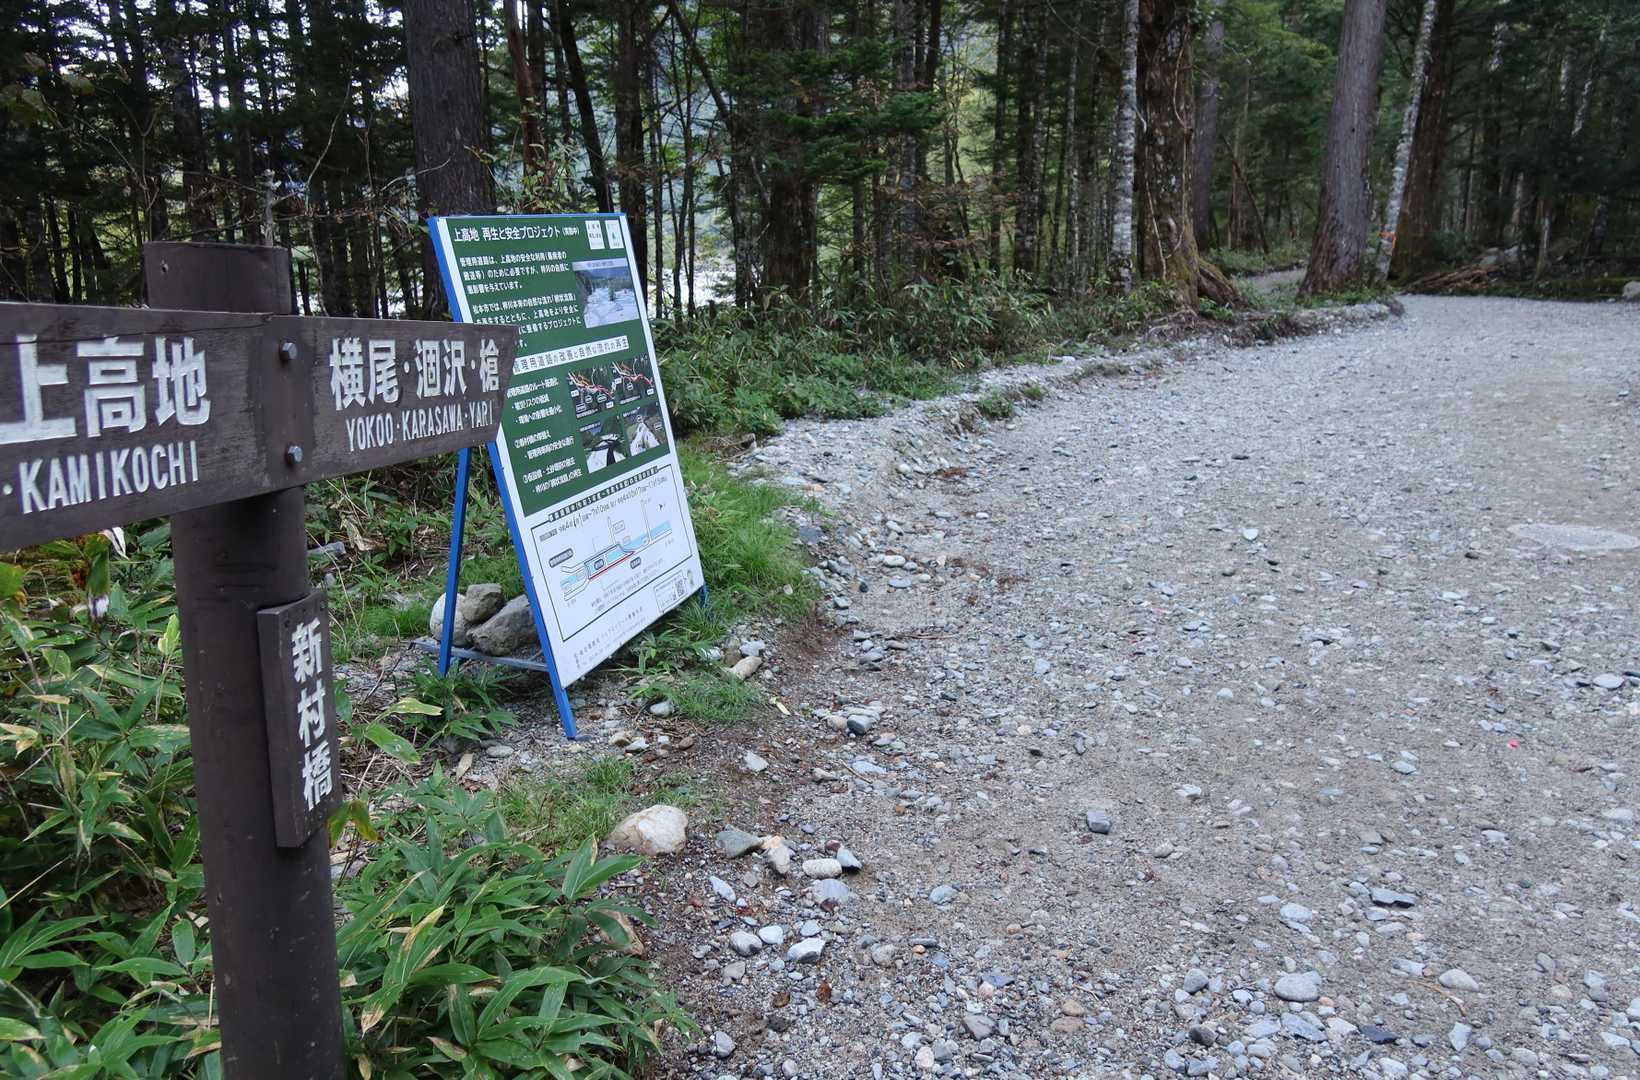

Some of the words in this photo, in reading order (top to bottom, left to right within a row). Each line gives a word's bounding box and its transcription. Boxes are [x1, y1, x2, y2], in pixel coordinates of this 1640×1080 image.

[454, 227, 480, 242] 上高地
[482, 226, 560, 241] 再生と安全プロジェクト
[0, 334, 211, 445] 上高地
[291, 617, 333, 812] 新村橋
